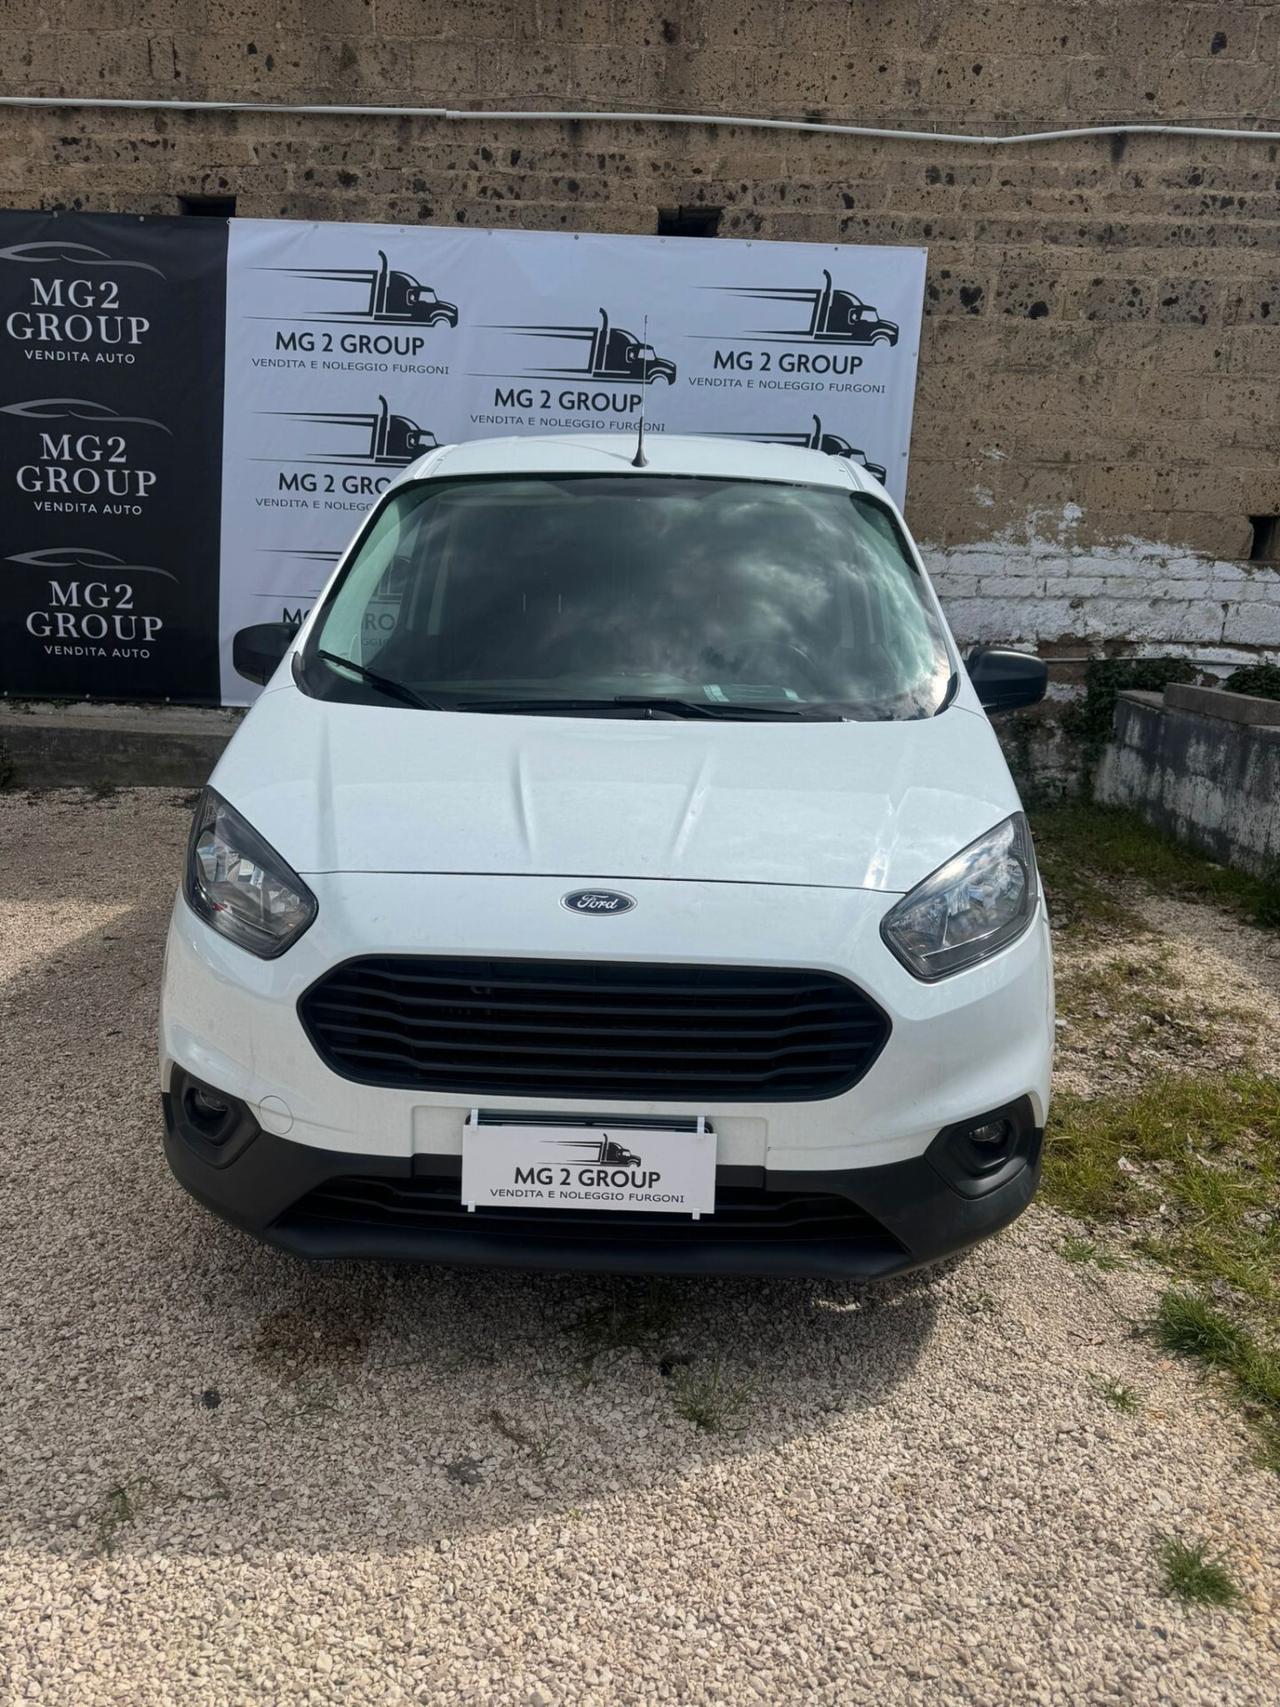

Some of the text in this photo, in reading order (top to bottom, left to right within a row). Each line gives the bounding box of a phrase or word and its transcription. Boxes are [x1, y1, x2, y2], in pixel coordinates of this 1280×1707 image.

[30, 277, 120, 309] MG2
[6, 311, 150, 344] GROUP
[275, 331, 425, 356] MG 2 GROUP
[24, 349, 136, 364] VENDITA AUTO
[251, 358, 449, 375] VENDITA E NOLEGGIO FURGONI
[713, 350, 863, 375] MG 2 GROUP
[688, 376, 886, 394] VENDITA E NOLEGGIO FURGONI
[494, 388, 643, 413] MG 2 GROUP
[470, 414, 665, 432] VENDITA E NOLEGGIO FURGONI
[39, 433, 127, 463] MG2
[16, 465, 157, 497] GROUP
[278, 472, 391, 495] MG 2 GRO
[34, 501, 142, 516] VENDITA AUTO
[255, 498, 309, 509] VENDITA
[313, 500, 320, 509] E
[48, 580, 134, 609] MG2
[26, 611, 163, 641] GROUP
[44, 645, 150, 659] VENDITA AUTO
[577, 894, 619, 909] Ford
[514, 1166, 661, 1189] MG 2 GROUP
[490, 1188, 684, 1203] VENDITA E NOLEGGIO FURGONI
